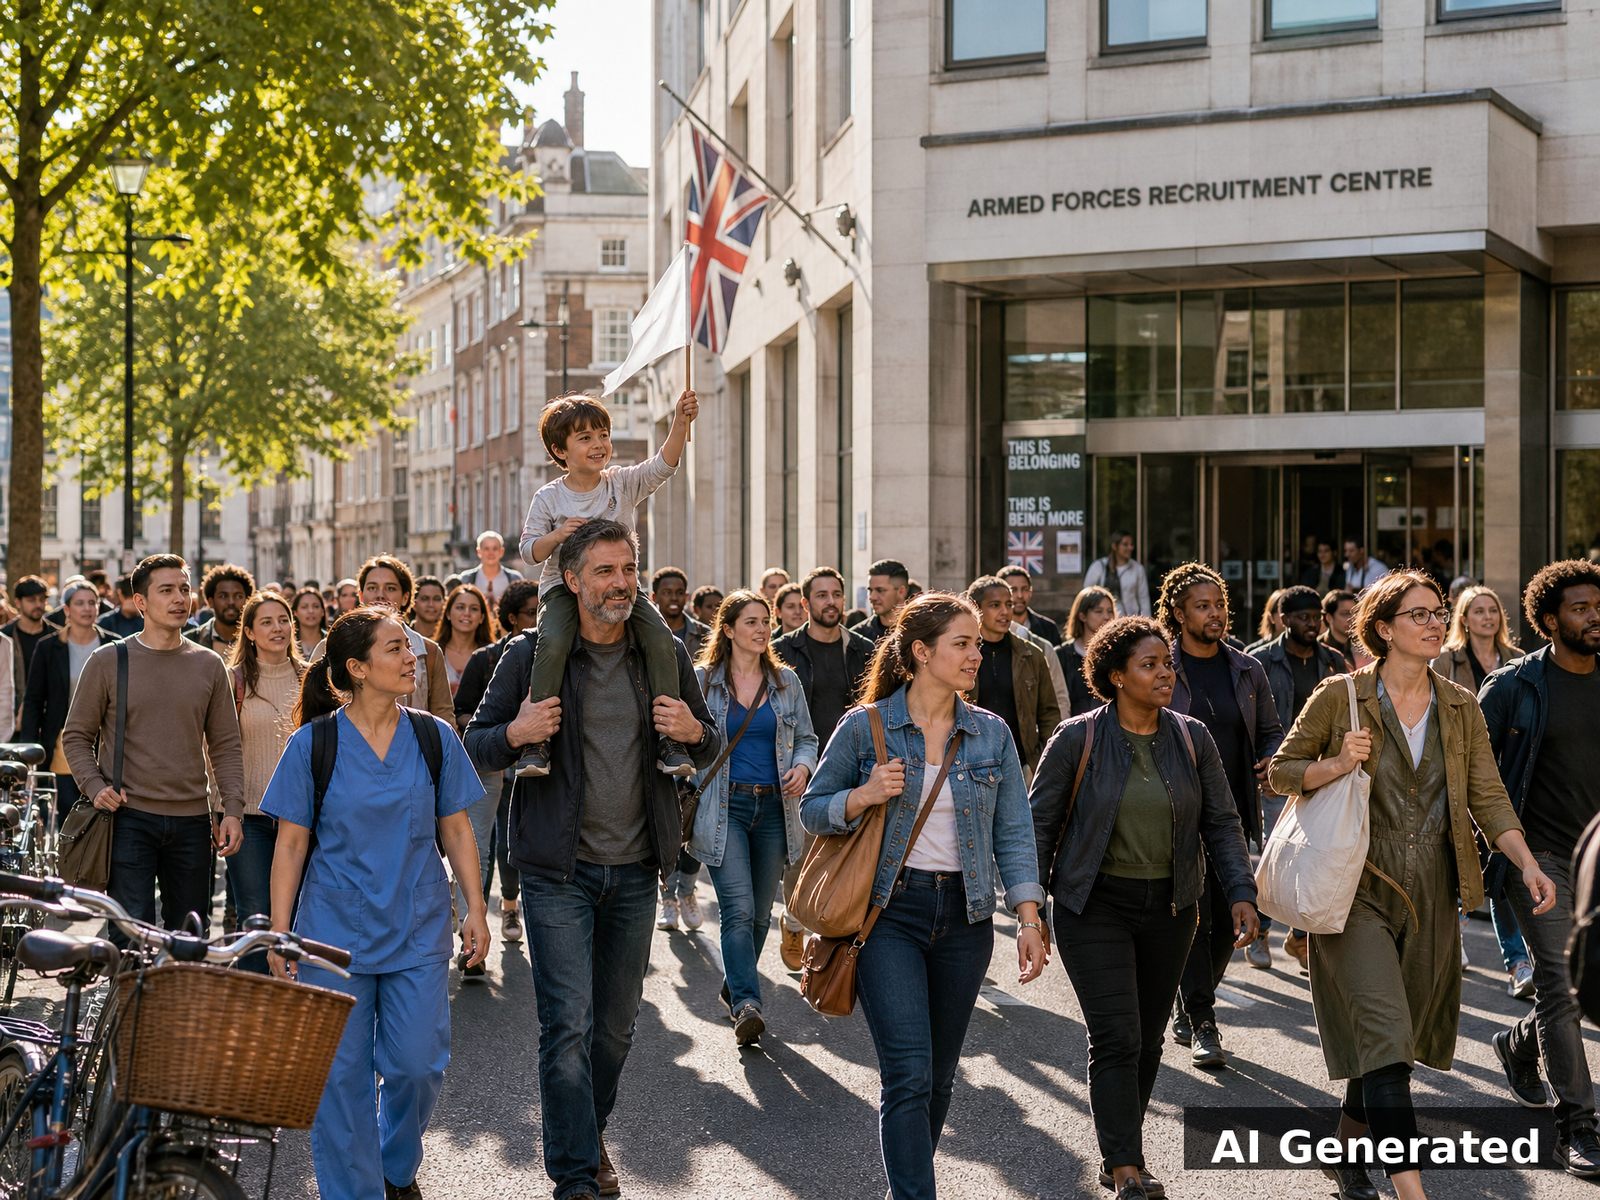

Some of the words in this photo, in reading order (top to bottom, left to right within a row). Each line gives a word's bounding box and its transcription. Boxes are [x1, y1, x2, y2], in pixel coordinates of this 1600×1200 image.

[967, 194, 1045, 218] ARMED
[1051, 186, 1141, 212] FORCES
[1148, 174, 1323, 206] RECRUITMENT
[1329, 166, 1433, 193] CENTRE
[1007, 440, 1036, 455] THIS
[1038, 439, 1051, 454] IS
[1008, 453, 1081, 470] BELONGING
[1007, 496, 1036, 511] THIS
[1038, 496, 1051, 511] IS
[1008, 511, 1045, 527] BEING
[1047, 510, 1084, 526] MORE
